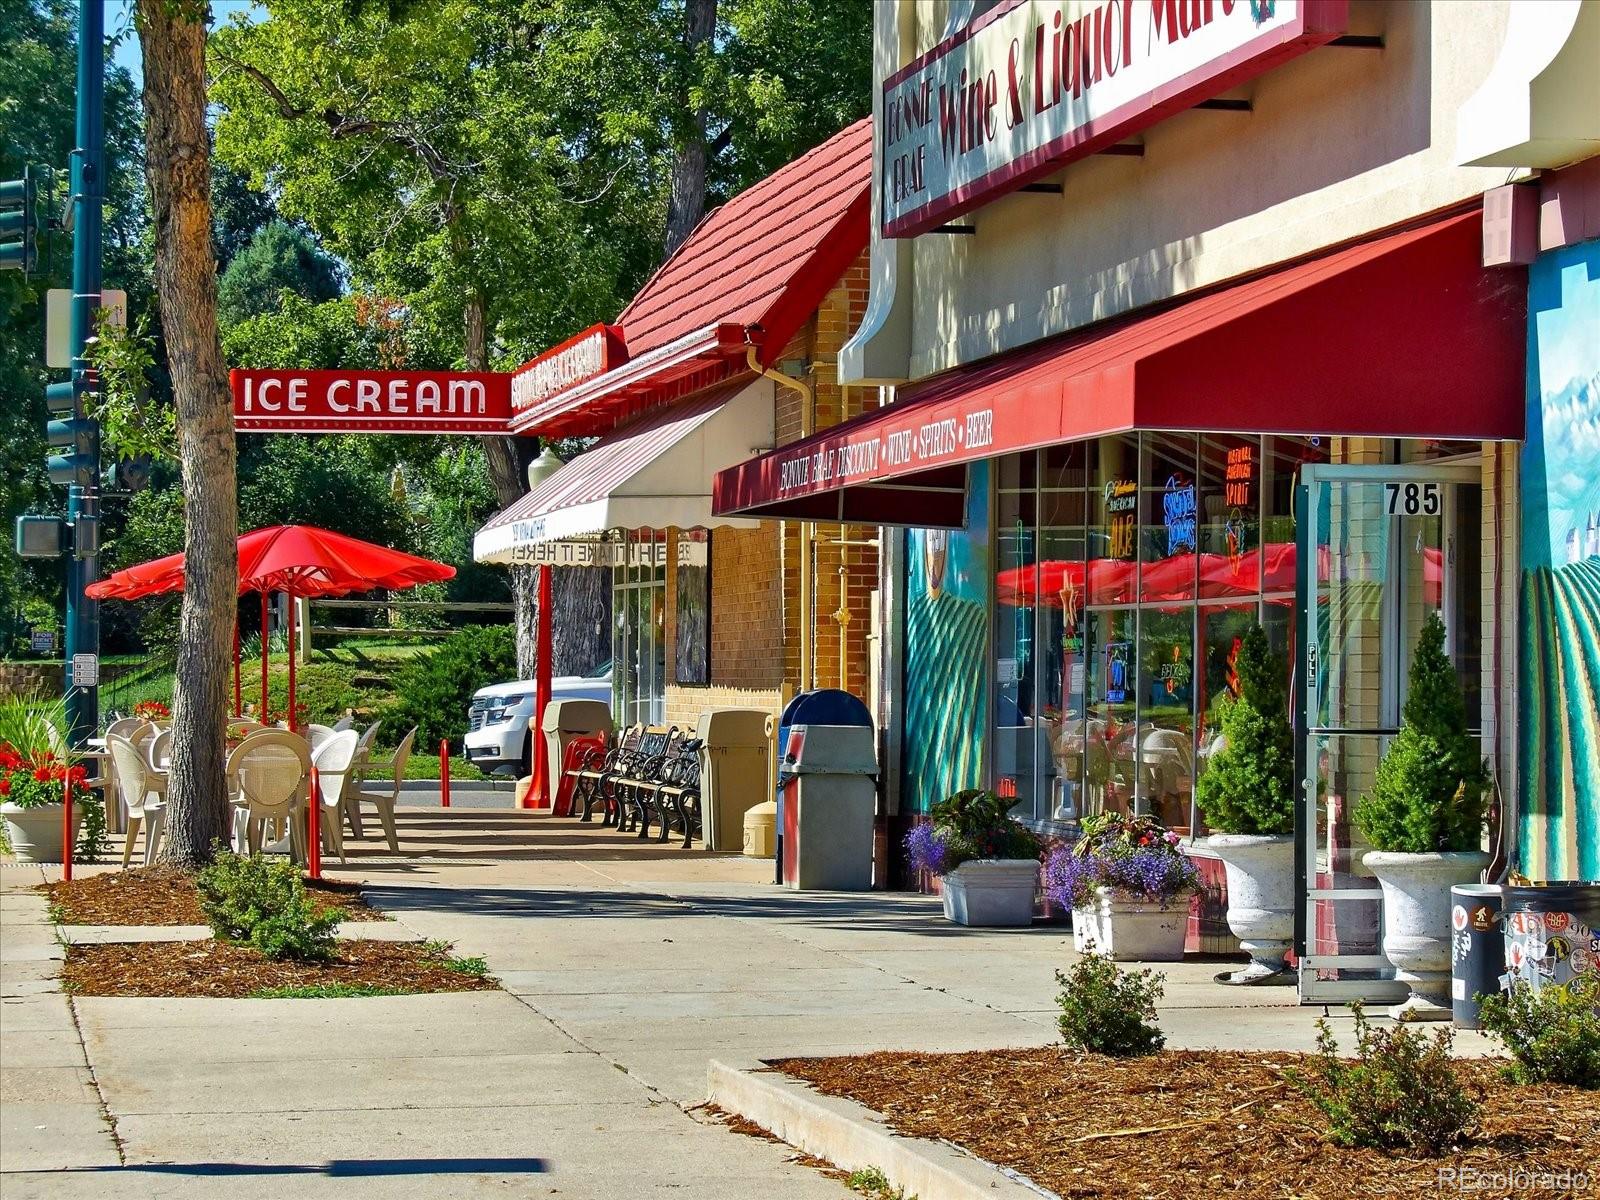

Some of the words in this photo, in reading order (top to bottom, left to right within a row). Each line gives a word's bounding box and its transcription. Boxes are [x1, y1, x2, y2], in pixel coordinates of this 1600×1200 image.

[938, 68, 998, 168] Wine
[1006, 37, 1024, 130] &
[1035, 0, 1132, 115] Liquor
[888, 77, 933, 147] BONNIE
[894, 144, 925, 204] BRAE
[244, 378, 307, 411] ICE
[327, 379, 486, 414] CREAM
[779, 455, 810, 491] BONNIE
[813, 448, 834, 483] BRAE
[836, 438, 881, 478] DISCOUNT
[887, 429, 912, 466] WINE
[918, 418, 957, 460] SPIRITS
[965, 409, 993, 449] BEER
[1386, 483, 1438, 515] 785
[1308, 646, 1316, 678] PULL
[1570, 923, 1590, 937] 90
